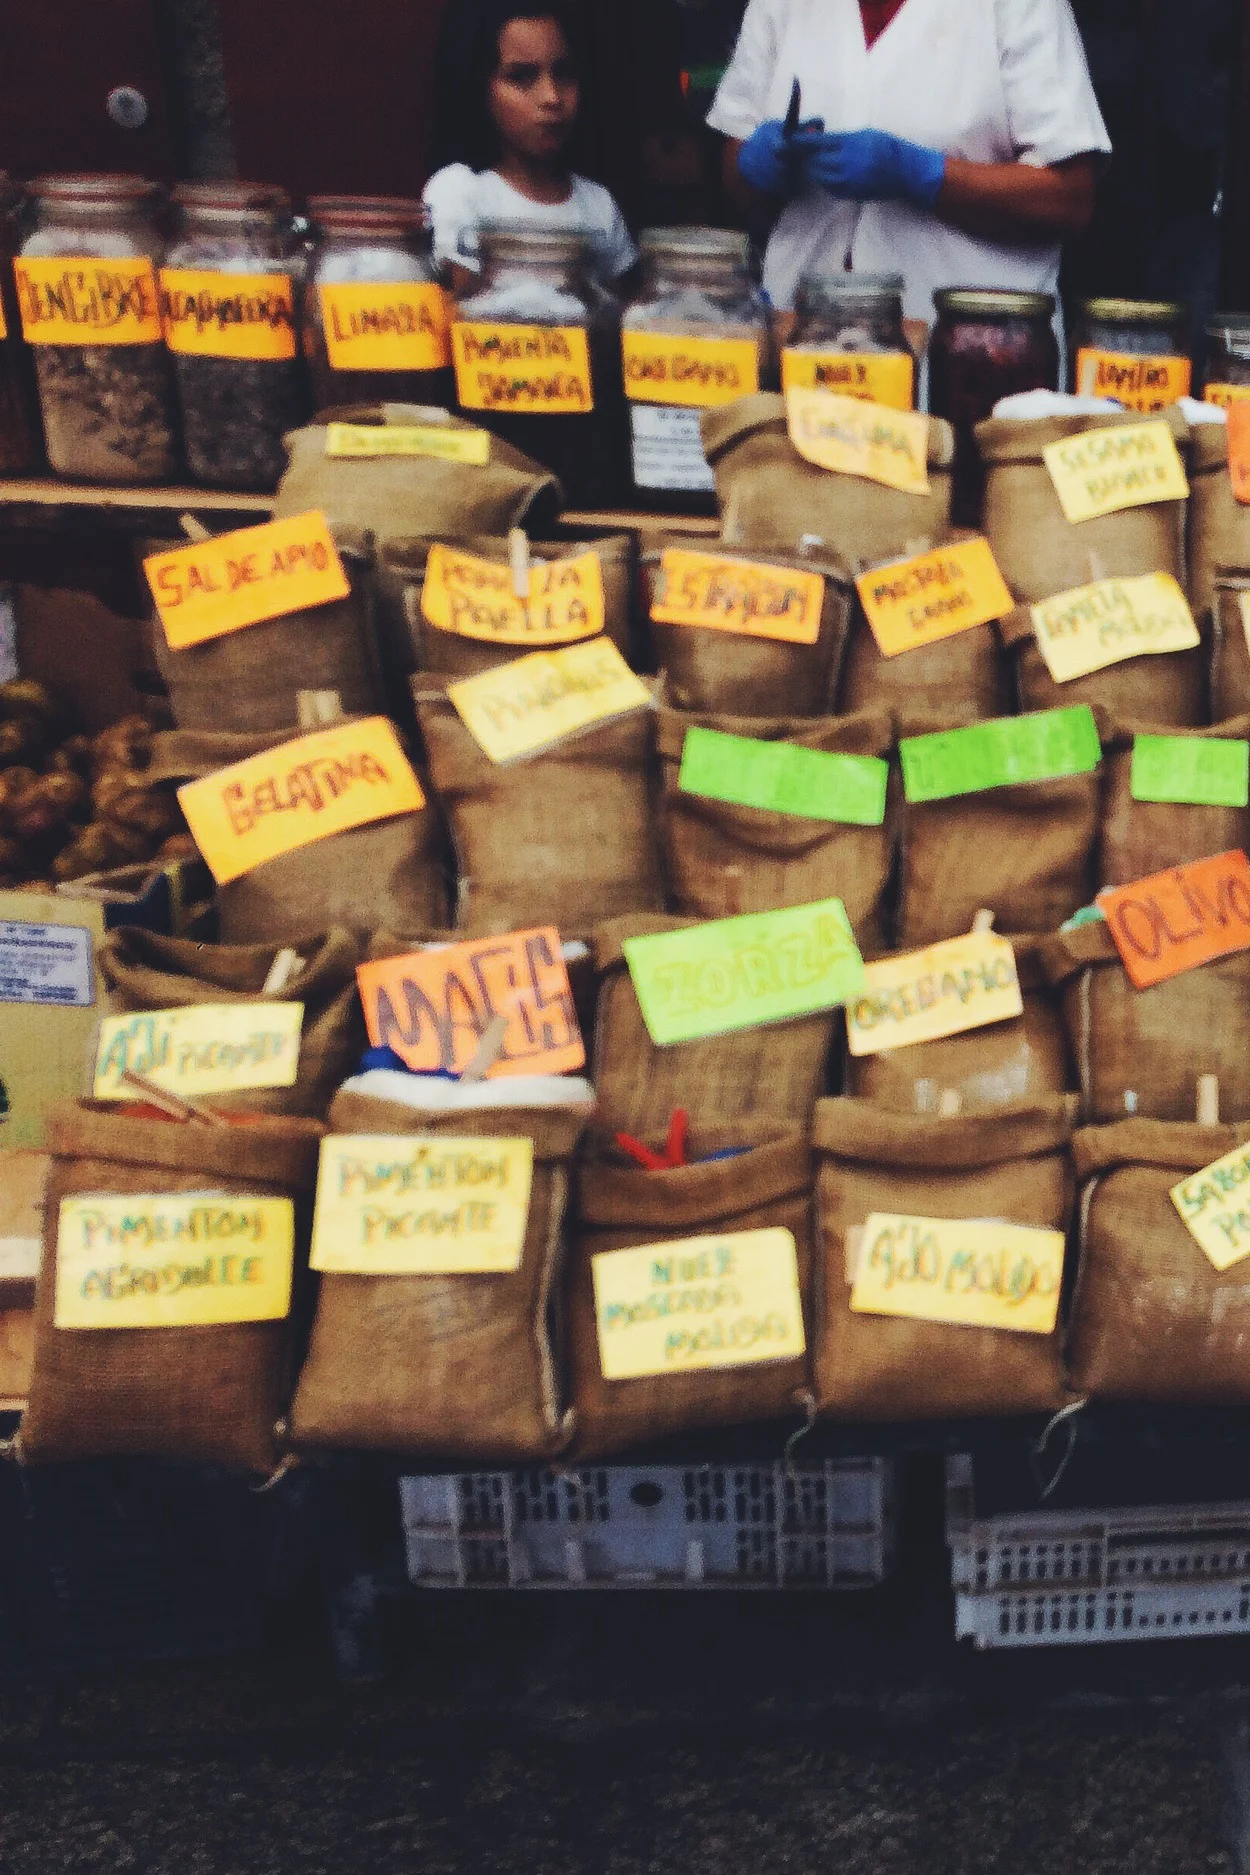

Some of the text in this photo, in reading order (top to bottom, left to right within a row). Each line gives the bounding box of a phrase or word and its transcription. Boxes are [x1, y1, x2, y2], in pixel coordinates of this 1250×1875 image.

[153, 563, 220, 609] SAL
[225, 552, 264, 593] DE
[221, 750, 393, 838] GELATINA
[652, 912, 855, 1017] ZORZA
